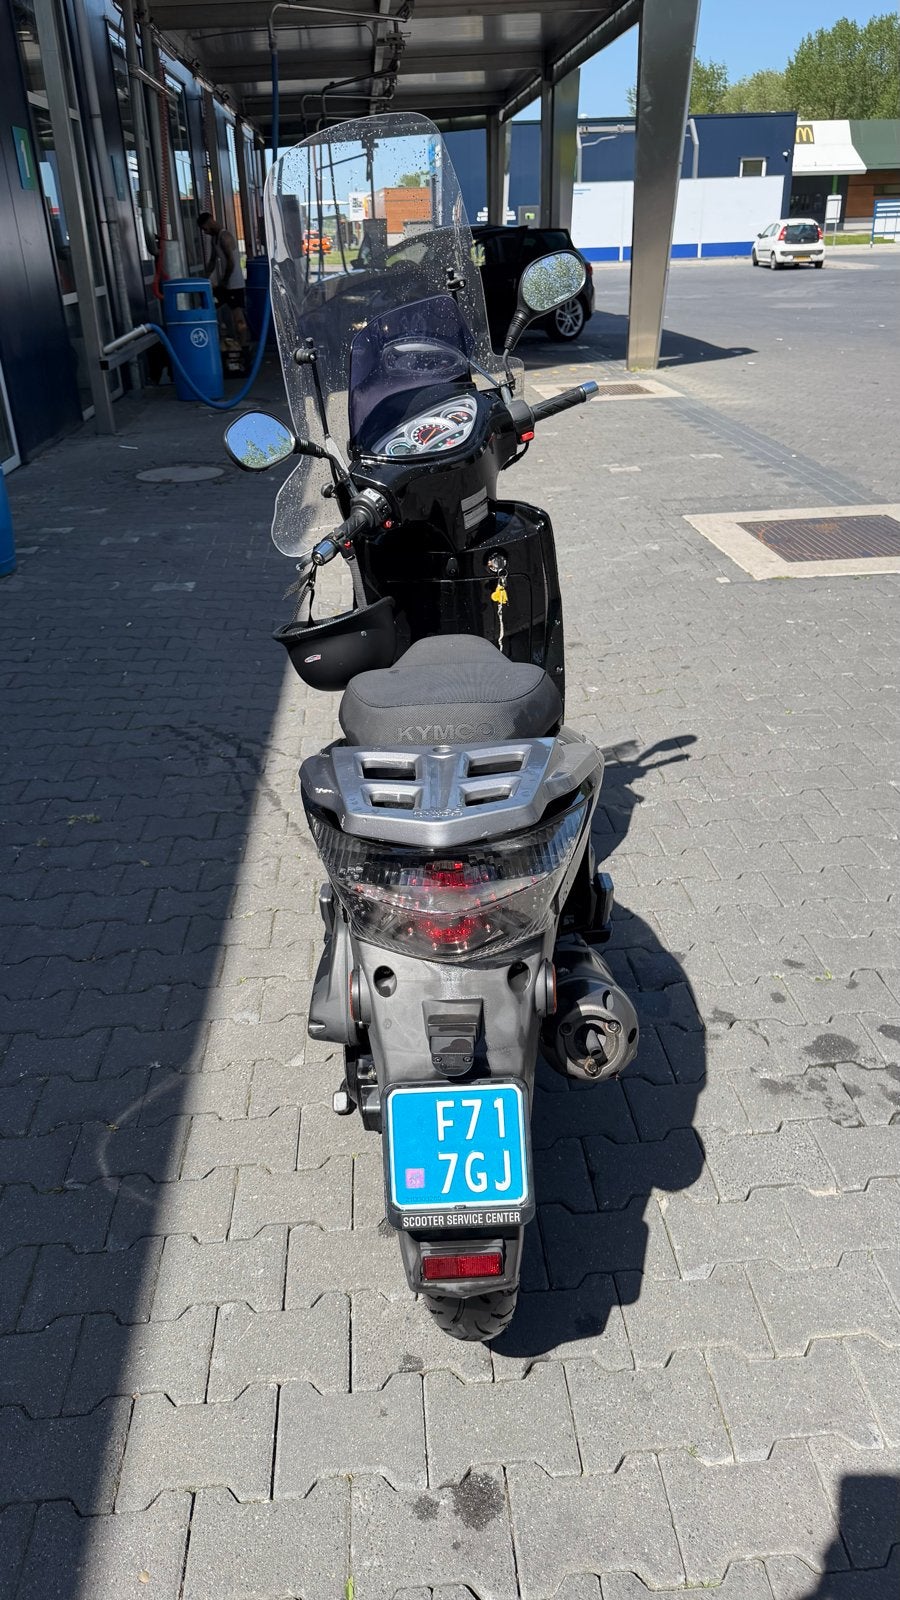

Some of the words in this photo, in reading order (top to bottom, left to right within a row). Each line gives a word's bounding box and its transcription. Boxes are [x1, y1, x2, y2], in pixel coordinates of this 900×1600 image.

[397, 722, 496, 741] KYMCO
[435, 1097, 506, 1142] F71
[438, 1149, 512, 1194] 7GJ
[402, 1214, 445, 1228] SCOOTER
[446, 1213, 484, 1226] SERVICE
[485, 1211, 521, 1224] CENTER
